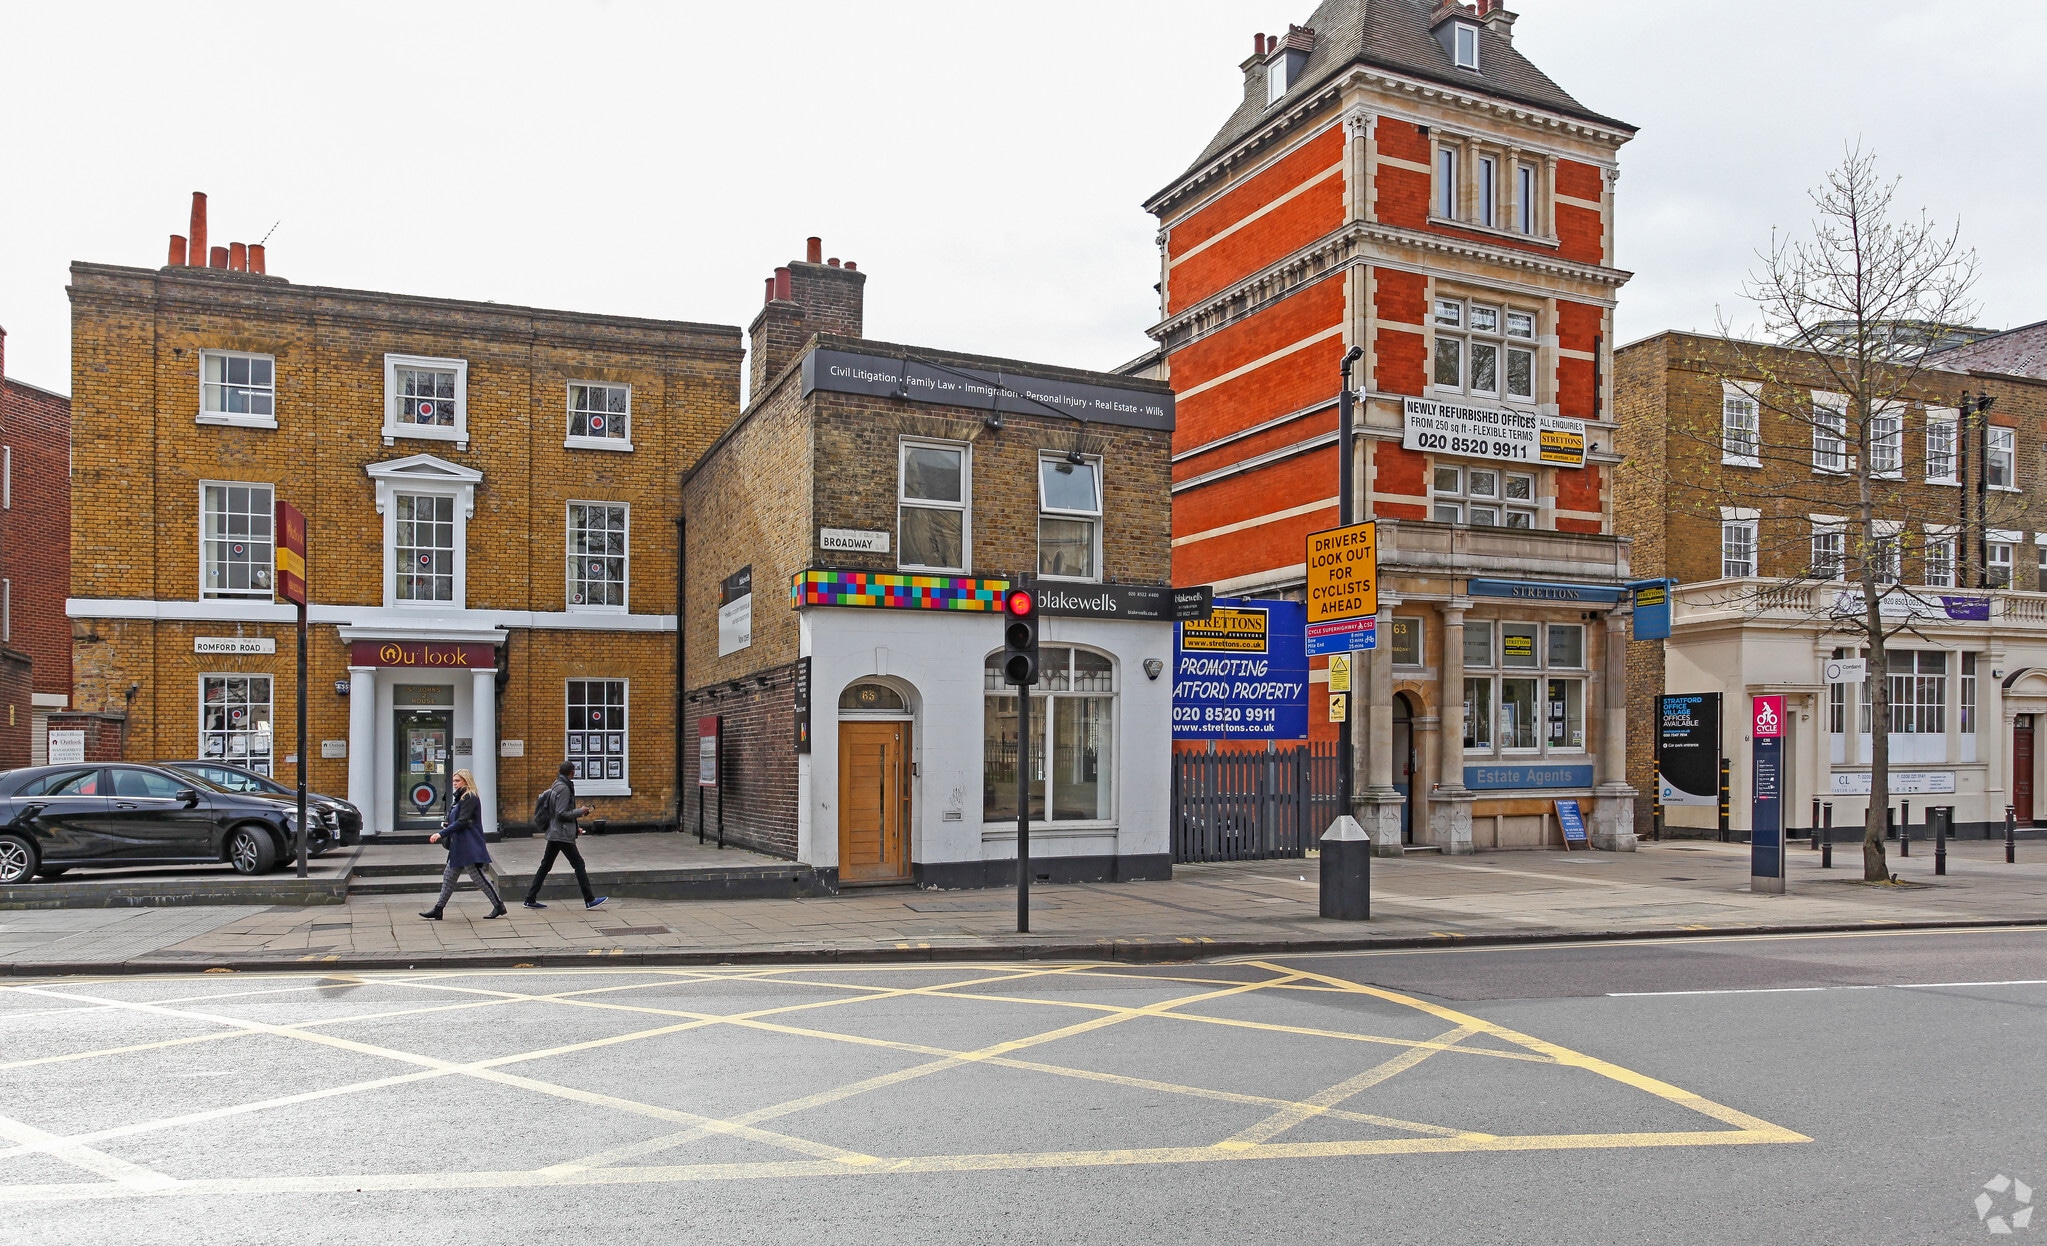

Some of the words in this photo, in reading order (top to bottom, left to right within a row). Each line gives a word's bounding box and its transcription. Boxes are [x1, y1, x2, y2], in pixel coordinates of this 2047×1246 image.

[830, 366, 850, 377] Civil
[853, 368, 896, 384] Litigation
[906, 375, 936, 390] Family
[938, 379, 955, 390] Law
[965, 382, 1018, 398] Immigration
[1026, 390, 1062, 404] Personal
[1063, 395, 1087, 409] Injury
[1096, 400, 1112, 410] Real
[1114, 402, 1138, 414] Estate
[1146, 406, 1164, 416] Wills
[1407, 400, 1437, 416] NEWLY
[1439, 405, 1499, 425] REFURBISHED
[1501, 413, 1536, 429] OFFICES
[1411, 416, 1434, 430] FROM
[1436, 419, 1448, 431] 250
[1450, 424, 1459, 435] sq
[1461, 423, 1467, 434] ft
[1473, 425, 1507, 439] FLEXIBLE
[1508, 429, 1534, 442] TERMS
[1540, 418, 1551, 428] ALL
[1552, 420, 1583, 432] ENQUIRIES
[1418, 432, 1447, 450] 020
[1452, 436, 1488, 455] 8520
[1492, 442, 1527, 459] 9911
[1542, 435, 1582, 446] STRETTONS
[824, 537, 873, 549] BROADWAY
[1316, 530, 1367, 552] DRIVERS
[1312, 552, 1342, 568] LOOK
[1346, 546, 1372, 562] OUT
[1330, 566, 1352, 581] FOR
[1174, 592, 1203, 603] blakewells
[1312, 580, 1370, 600] CYCLISTS
[1513, 586, 1580, 599] STRETTONS
[1038, 590, 1117, 612] blakewells
[1320, 598, 1362, 614] AHEAD
[1188, 616, 1262, 630] STRETTONS
[1308, 627, 1322, 635] CYCLE
[1322, 624, 1357, 634] SUPERHIGHWAY
[1393, 623, 1407, 634] 63
[197, 643, 236, 651] ROMFORD
[240, 644, 261, 652] ROAD
[1188, 640, 1262, 649] www.strettons.co.uk
[380, 642, 468, 666] Oulook
[1180, 658, 1269, 677] PROMOTING
[862, 690, 875, 701] 65
[1232, 682, 1303, 700] PROPERTY
[1173, 706, 1200, 721] 020
[1205, 707, 1242, 722] 8520
[1246, 708, 1276, 722] 9911
[1173, 723, 1275, 732] www.strettons.co.uk
[1478, 769, 1520, 784] Estate
[1526, 769, 1572, 785] Agents
[1838, 776, 1850, 785] CL
